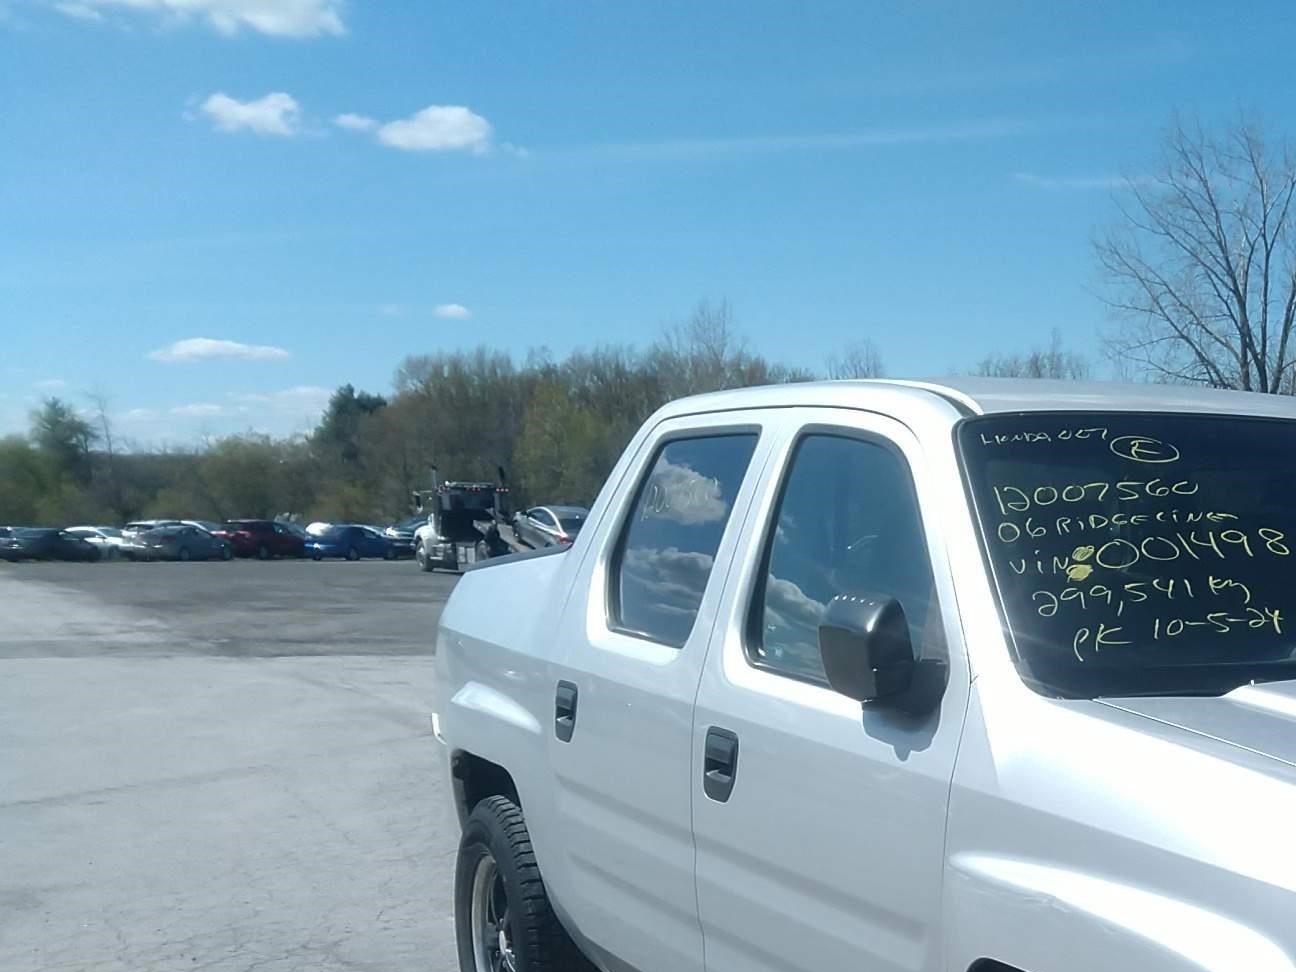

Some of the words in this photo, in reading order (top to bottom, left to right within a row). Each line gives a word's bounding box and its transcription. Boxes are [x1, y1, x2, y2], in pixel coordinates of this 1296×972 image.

[993, 478, 1199, 515] 12007560
[998, 518, 1047, 542] 06
[1096, 528, 1290, 569] 001498
[1032, 578, 1195, 617] 299,541
[1153, 607, 1284, 640] 10-5-24
